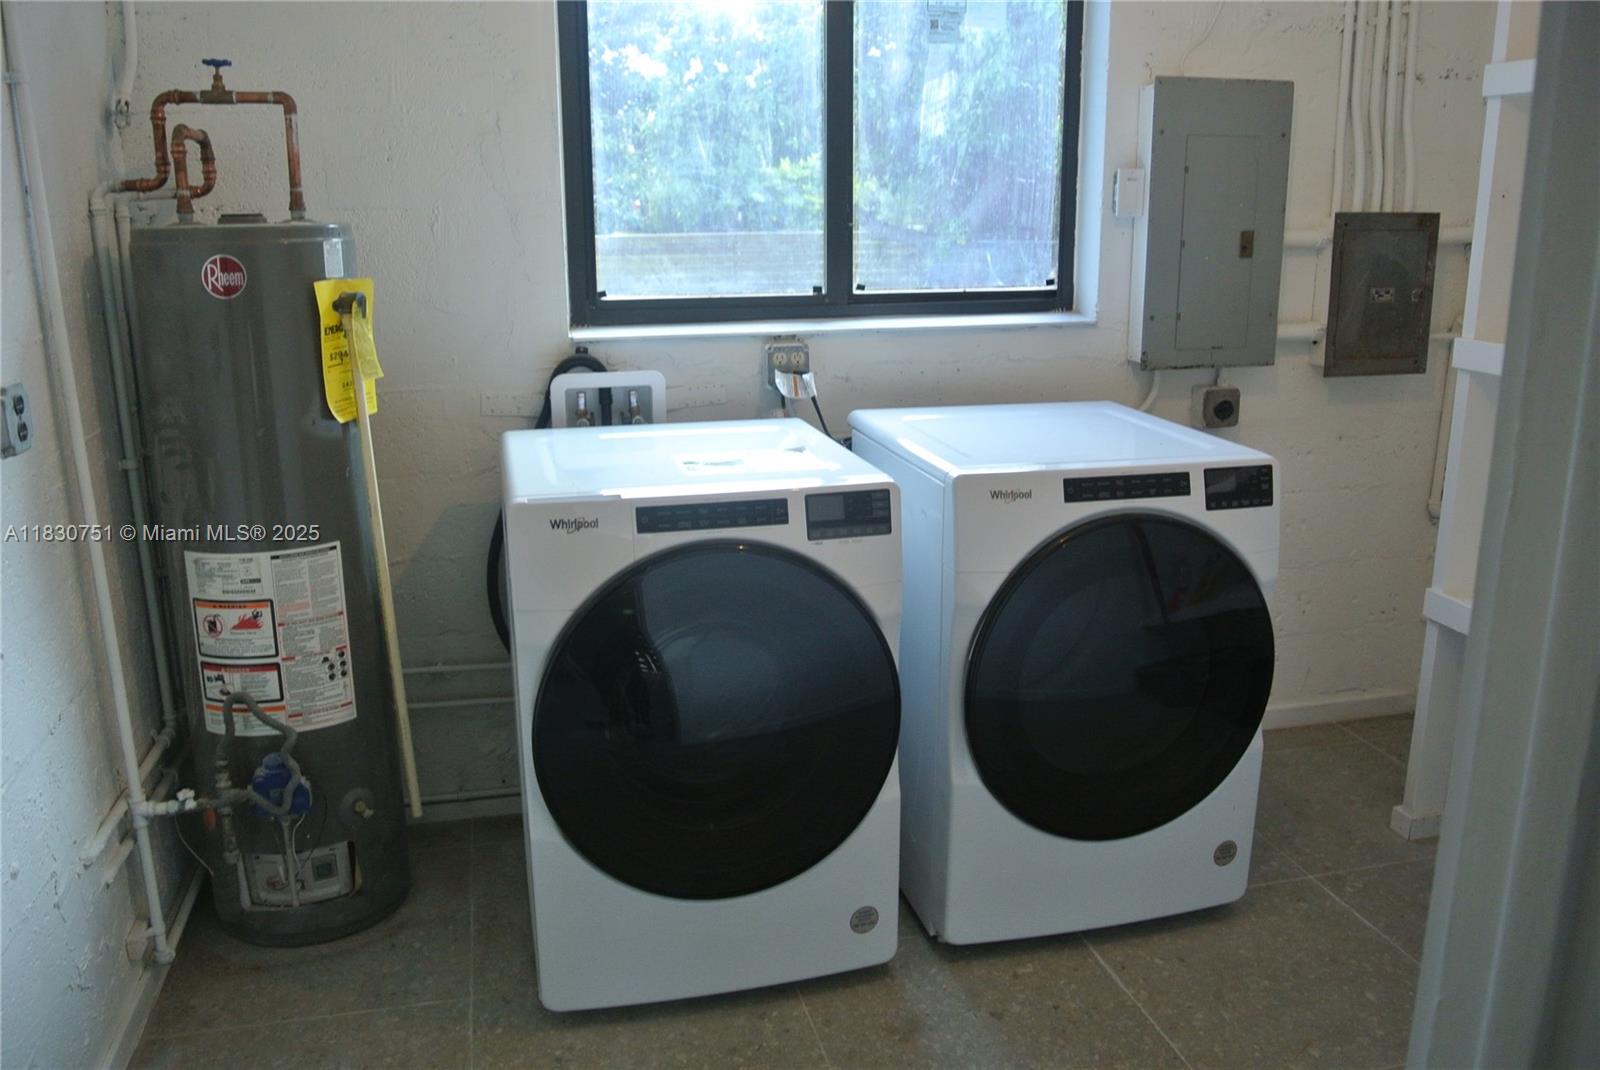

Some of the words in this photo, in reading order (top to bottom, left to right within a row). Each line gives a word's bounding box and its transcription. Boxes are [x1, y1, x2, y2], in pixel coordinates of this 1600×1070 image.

[207, 256, 244, 292] Rheem
[989, 488, 1032, 503] Whirlpool
[549, 516, 599, 533] Whirlpool
